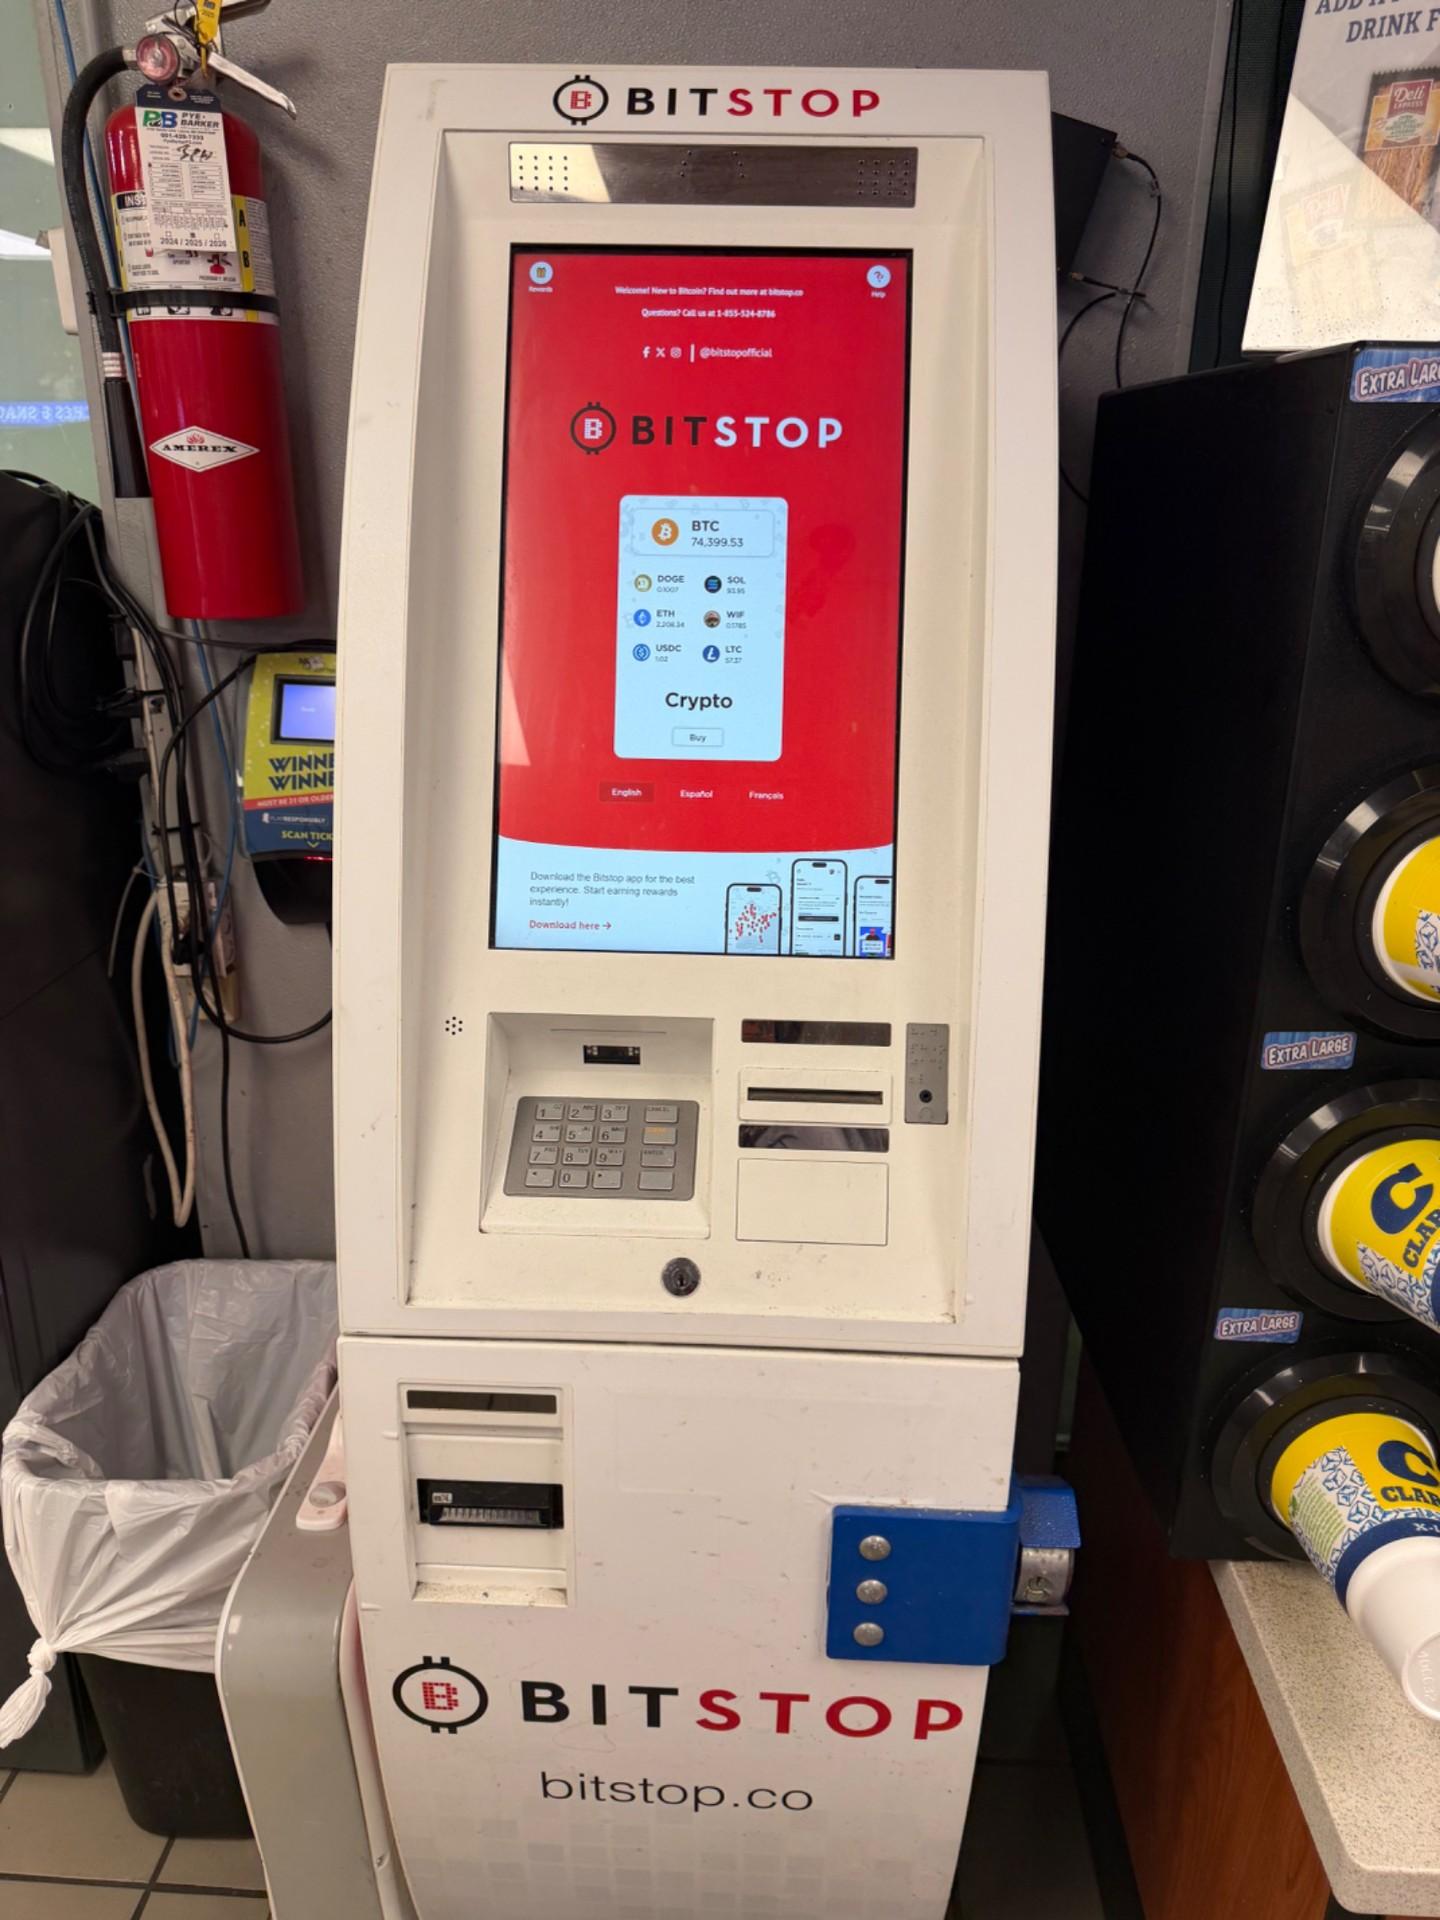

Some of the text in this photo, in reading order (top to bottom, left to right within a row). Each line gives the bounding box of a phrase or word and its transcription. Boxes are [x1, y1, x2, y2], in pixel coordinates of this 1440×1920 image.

[1345, 10, 1422, 42] DRINK
[627, 87, 880, 117] BITSTOP
[181, 120, 220, 128] BARKER
[615, 286, 650, 294] Welcome!
[651, 286, 667, 294] New
[669, 287, 677, 295] to
[678, 287, 706, 295] Bitcoin?
[708, 287, 724, 295] Find
[641, 308, 681, 318] Questions?
[682, 309, 696, 317] Call
[700, 347, 772, 359] @bitstopofficial
[1360, 362, 1440, 396] EXTRA LAR
[631, 415, 843, 449] BITSTOP
[162, 444, 238, 453] AMEREX
[691, 520, 720, 532] BTC
[691, 537, 744, 548] 74,399.53
[657, 575, 685, 584] DOGE
[727, 576, 746, 585] SOL
[656, 609, 676, 618] ETH
[726, 611, 745, 619] WIF
[655, 644, 682, 653] USDC
[725, 645, 742, 654] LTC
[665, 692, 733, 711] Crypto
[689, 733, 707, 743] Buy
[611, 788, 642, 798] English
[680, 789, 713, 799] Español
[749, 791, 784, 801] Français
[281, 830, 308, 839] SCAN
[530, 871, 695, 884] Download the Bitstop app for the best
[530, 886, 678, 898] experience. Start earning rewards
[529, 898, 569, 908] instantly!
[529, 920, 600, 930] Download here
[1268, 1037, 1349, 1065] EXTRA LARGE
[571, 1109, 579, 1118] 2
[604, 1109, 612, 1119] 3
[535, 1129, 543, 1138] 4
[568, 1130, 576, 1139] 5
[601, 1130, 609, 1140] 6
[533, 1151, 541, 1161] 7
[565, 1152, 574, 1162] 8
[599, 1153, 607, 1162] 9
[563, 1173, 571, 1183] 0
[1221, 1315, 1296, 1336] EXTRA LARGE
[521, 1680, 963, 1740] BITSTOP
[541, 1771, 813, 1813] bitstop.co
